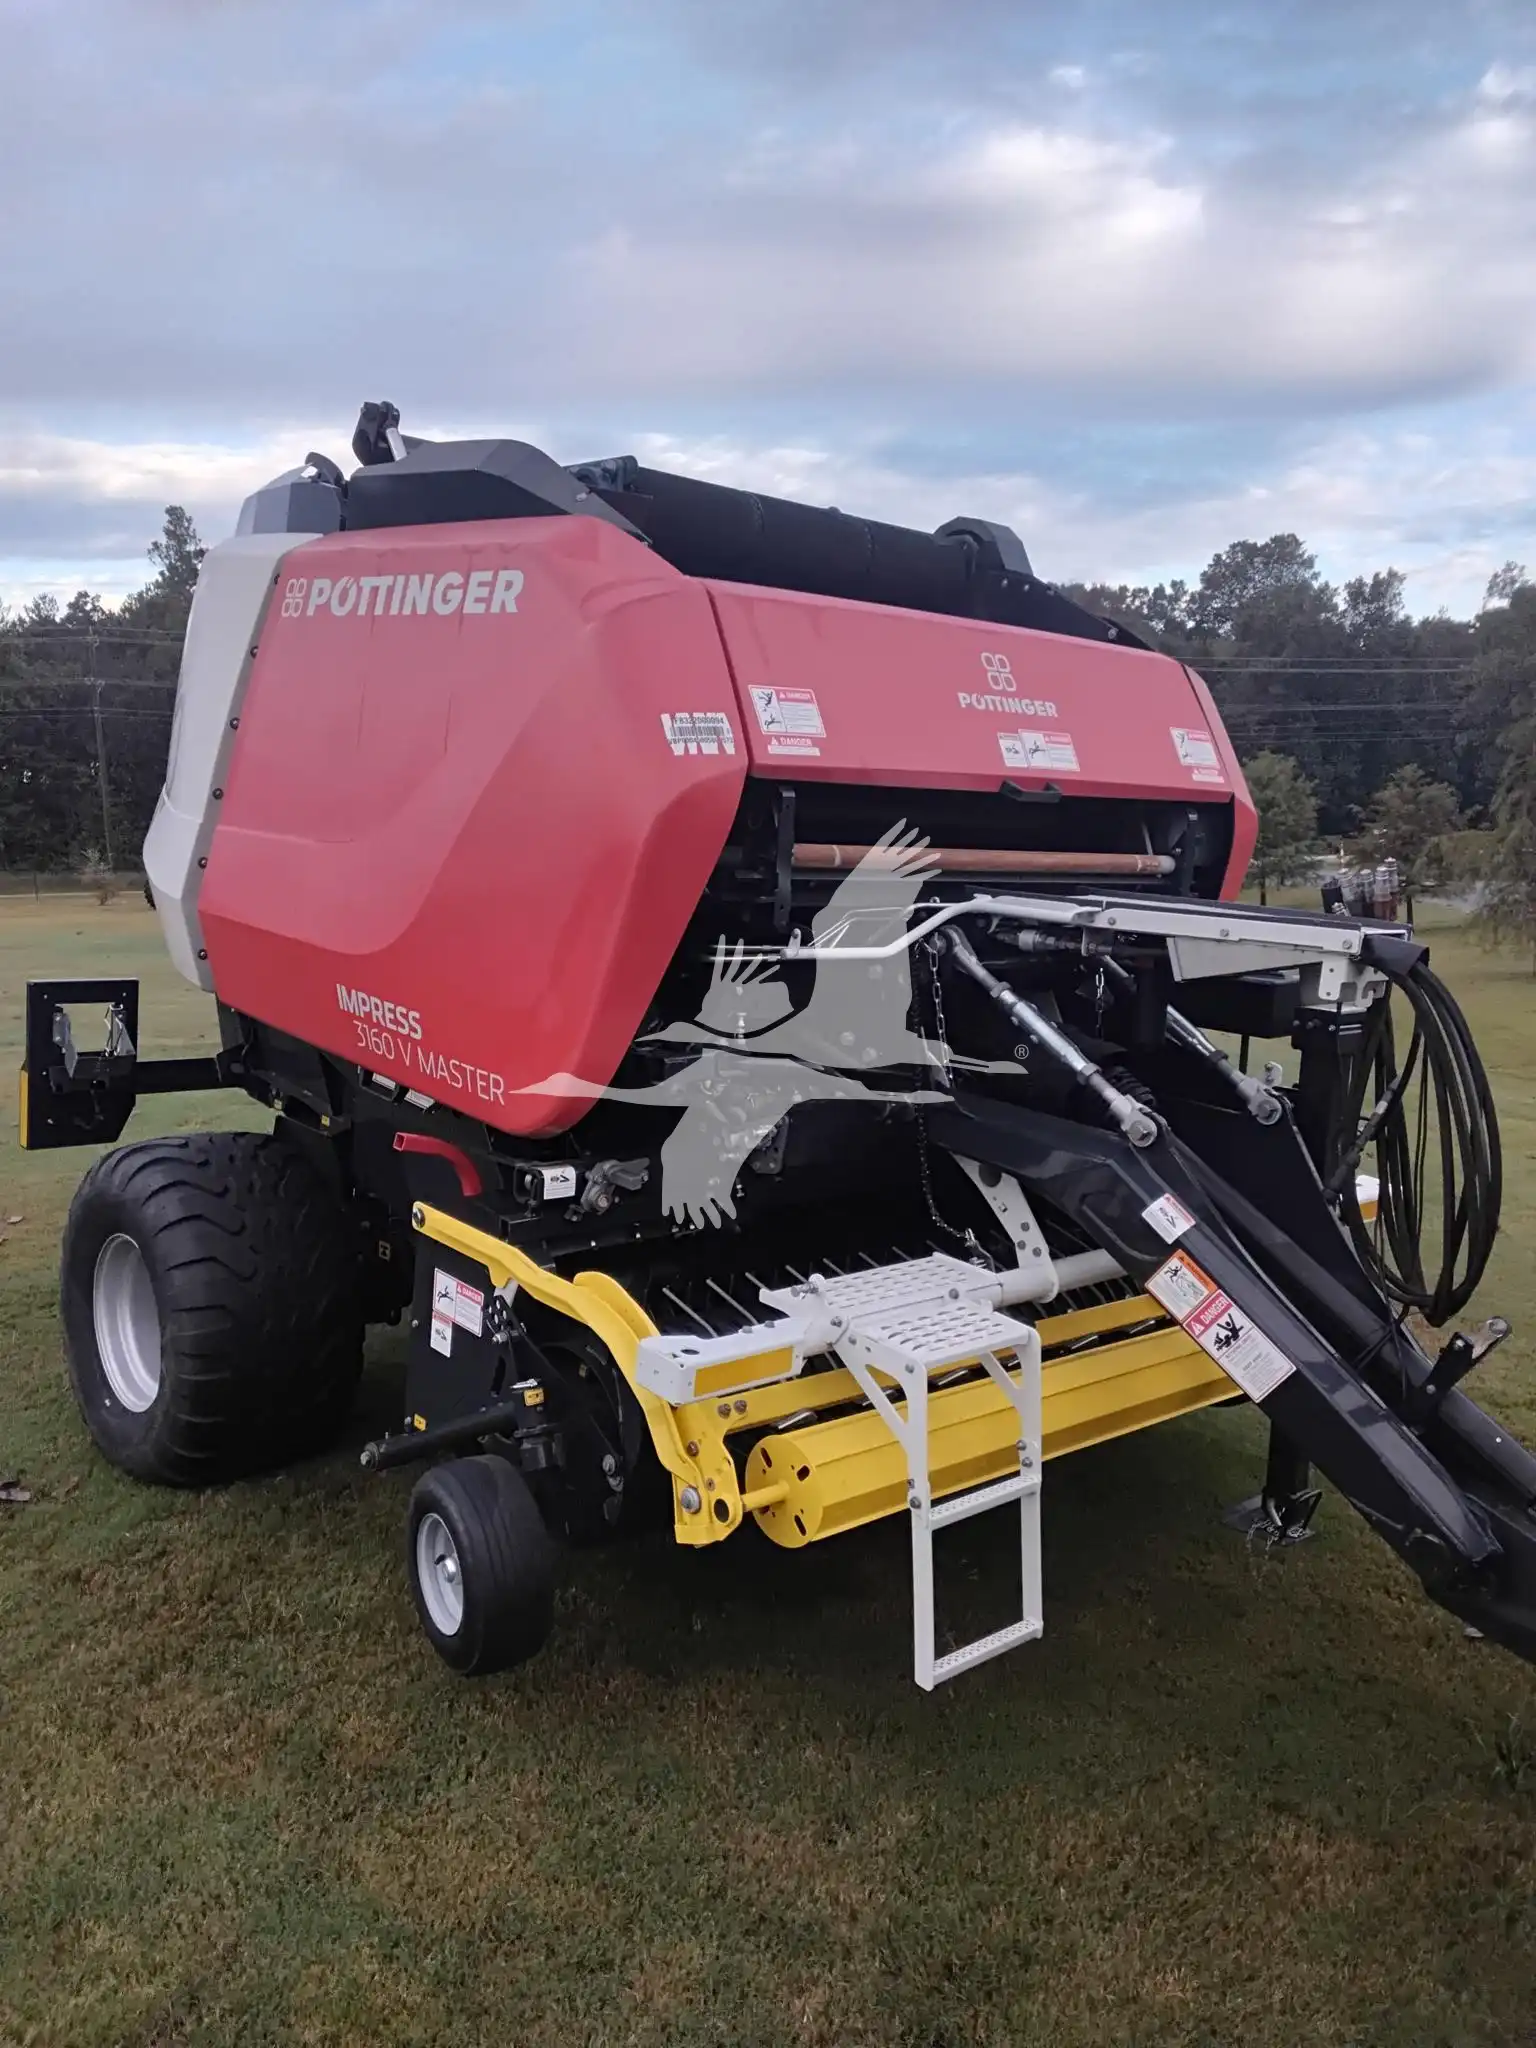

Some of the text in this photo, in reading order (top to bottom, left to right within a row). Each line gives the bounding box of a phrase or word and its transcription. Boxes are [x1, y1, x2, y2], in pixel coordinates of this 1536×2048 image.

[306, 569, 524, 616] PÖTTINGER
[957, 692, 1058, 718] PÖTTINGER
[336, 983, 422, 1040] IMPRESS
[353, 1020, 505, 1105] 3160 V MASTER
[1200, 1296, 1229, 1325] DANGER
